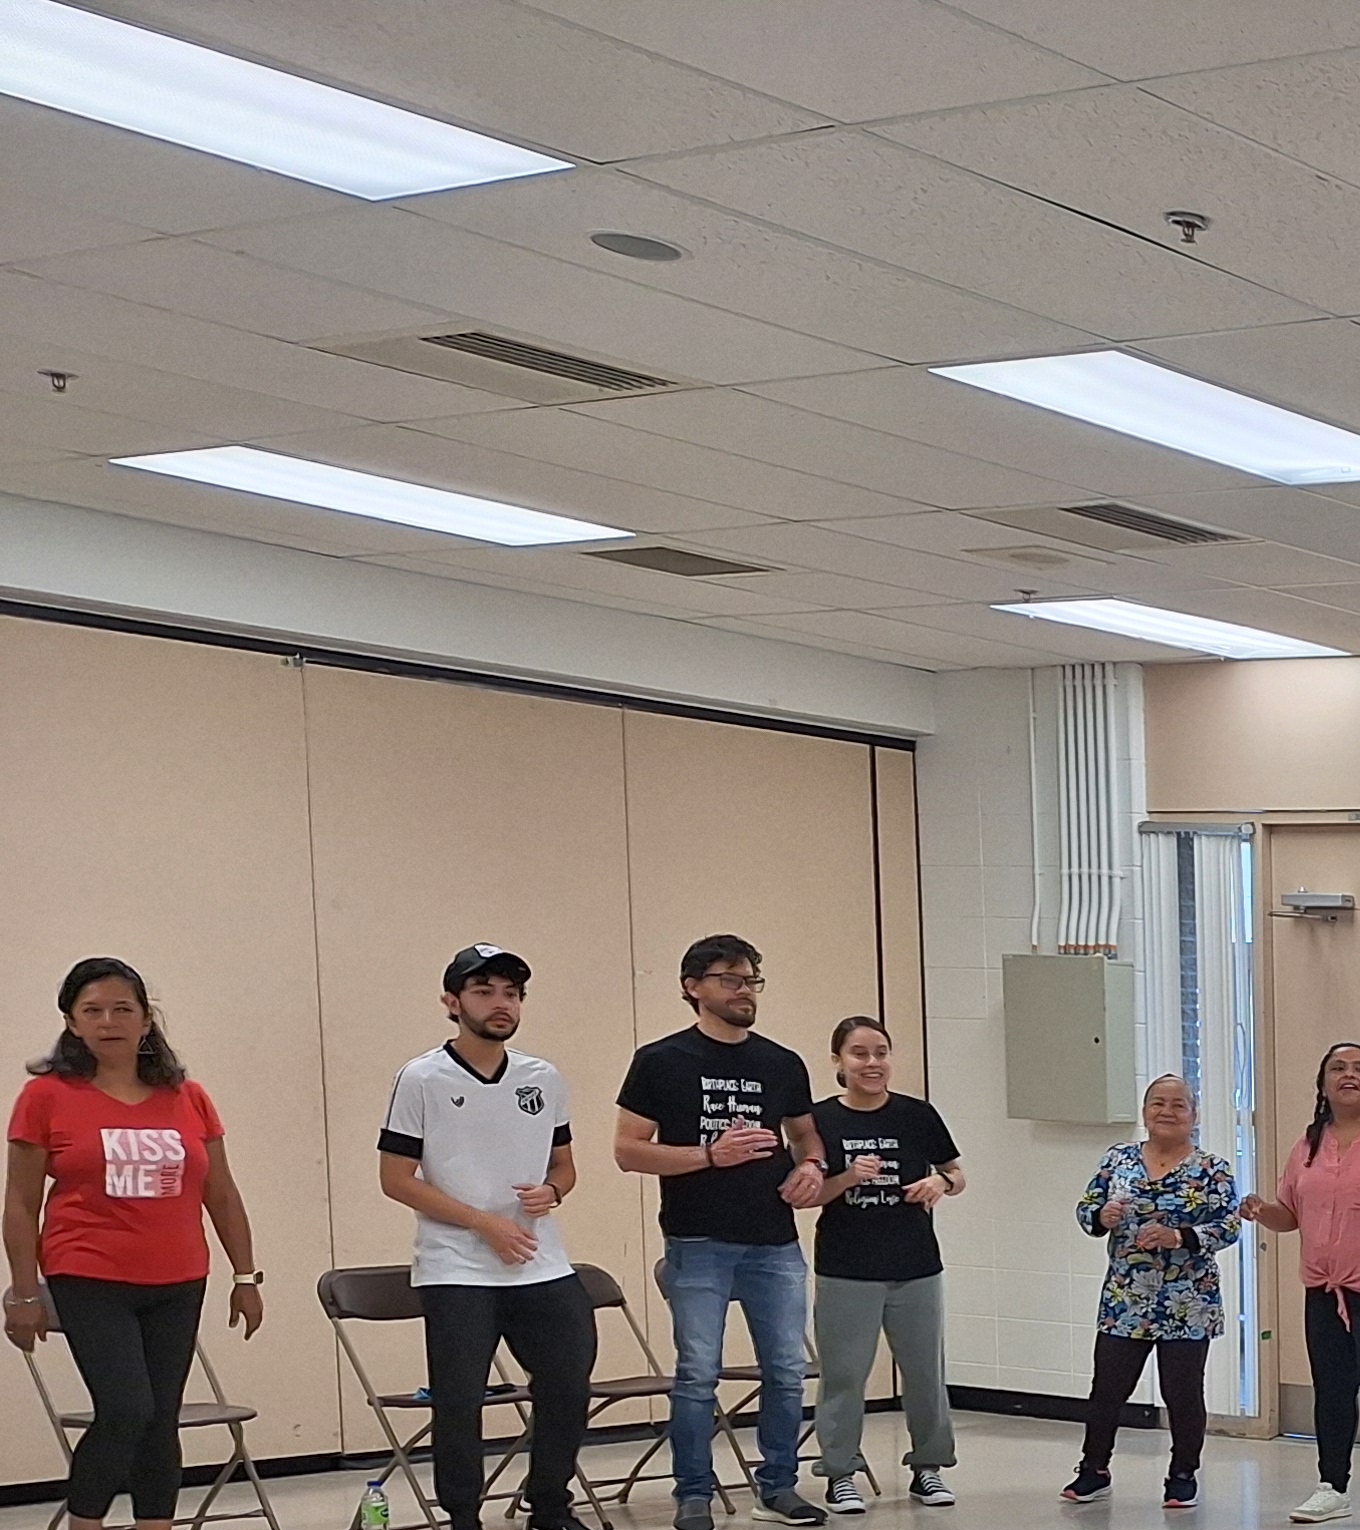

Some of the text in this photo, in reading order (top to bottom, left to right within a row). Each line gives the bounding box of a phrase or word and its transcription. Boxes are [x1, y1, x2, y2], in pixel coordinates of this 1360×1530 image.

[99, 1128, 186, 1162] KISS
[106, 1164, 158, 1197] ME
[160, 1164, 180, 1196] MORE
